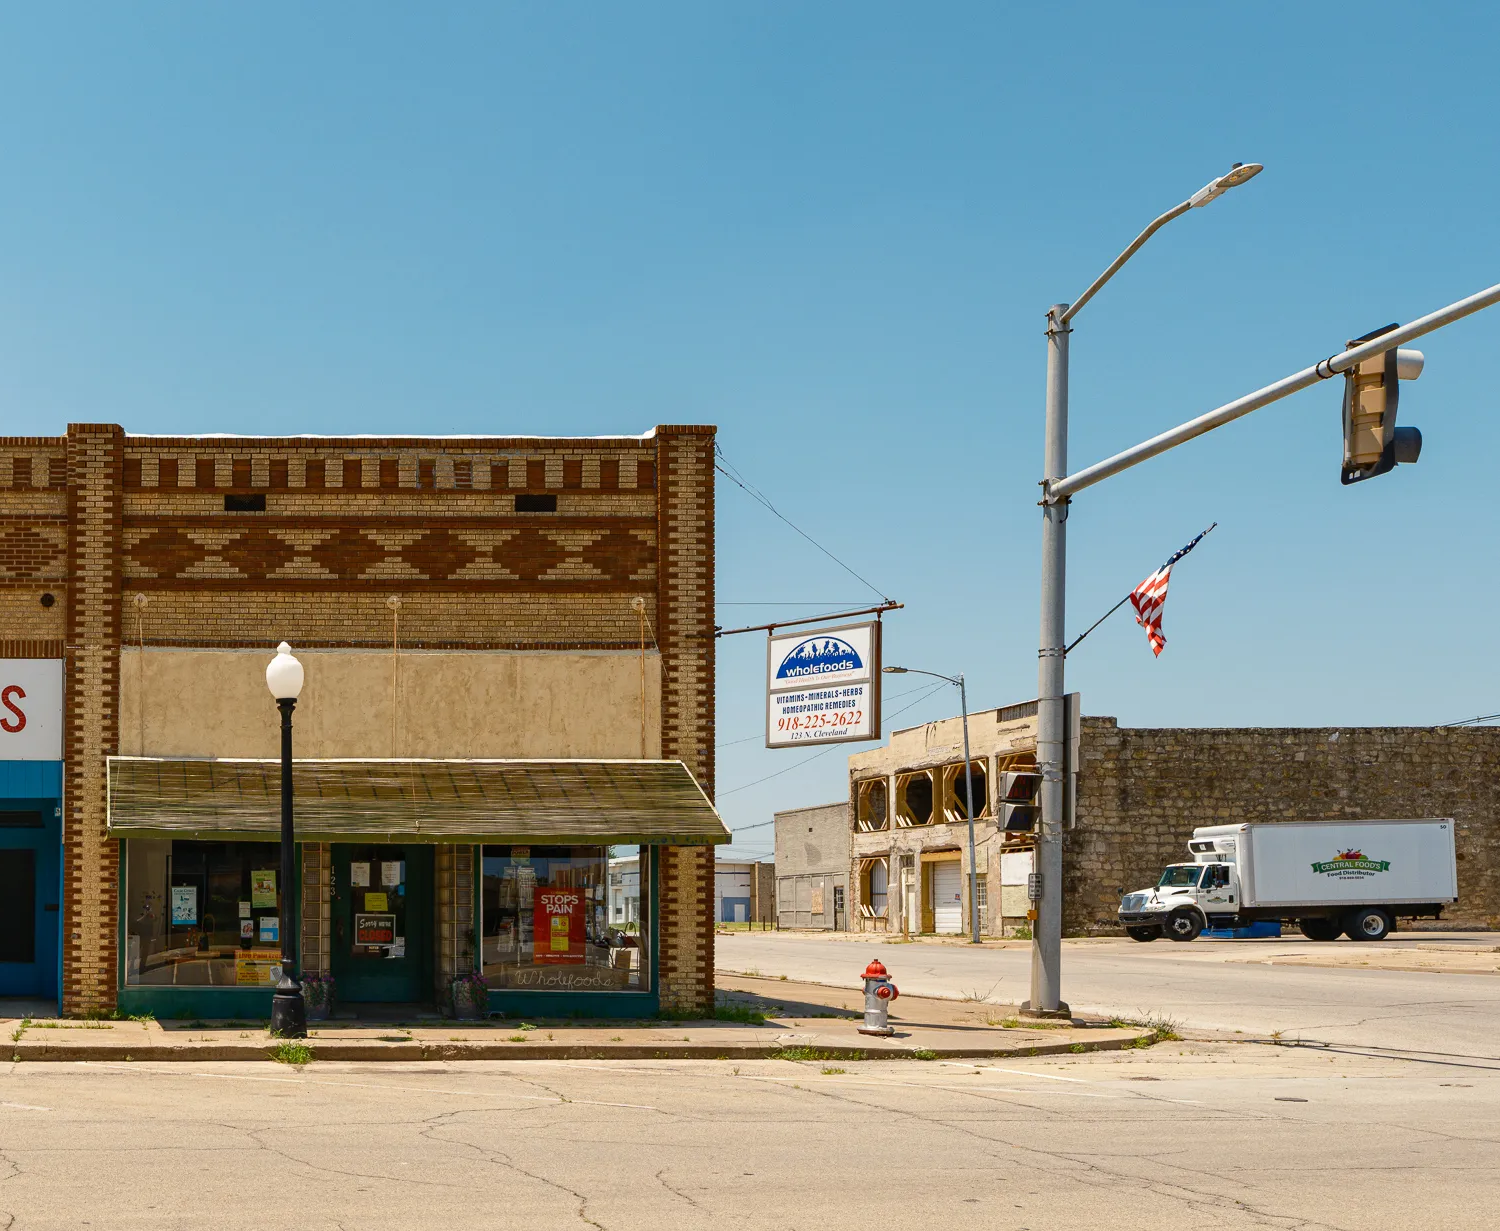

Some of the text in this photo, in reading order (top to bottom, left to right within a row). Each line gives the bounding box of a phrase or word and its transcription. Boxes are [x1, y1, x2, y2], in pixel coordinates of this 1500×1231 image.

[786, 660, 853, 677] wholefoods
[782, 699, 856, 714] HOMEOPATHIC REMEDIES
[778, 710, 862, 731] 918-225-2622
[790, 732, 802, 740] 123
[813, 728, 848, 738] Cleveland
[1321, 861, 1381, 871] CENTRAL FOOD'S
[541, 895, 579, 905] STOPS
[546, 904, 573, 914] PAIN
[359, 918, 377, 928] Sorry
[358, 929, 392, 942] CLOSED
[514, 970, 614, 989] Wholefoods
